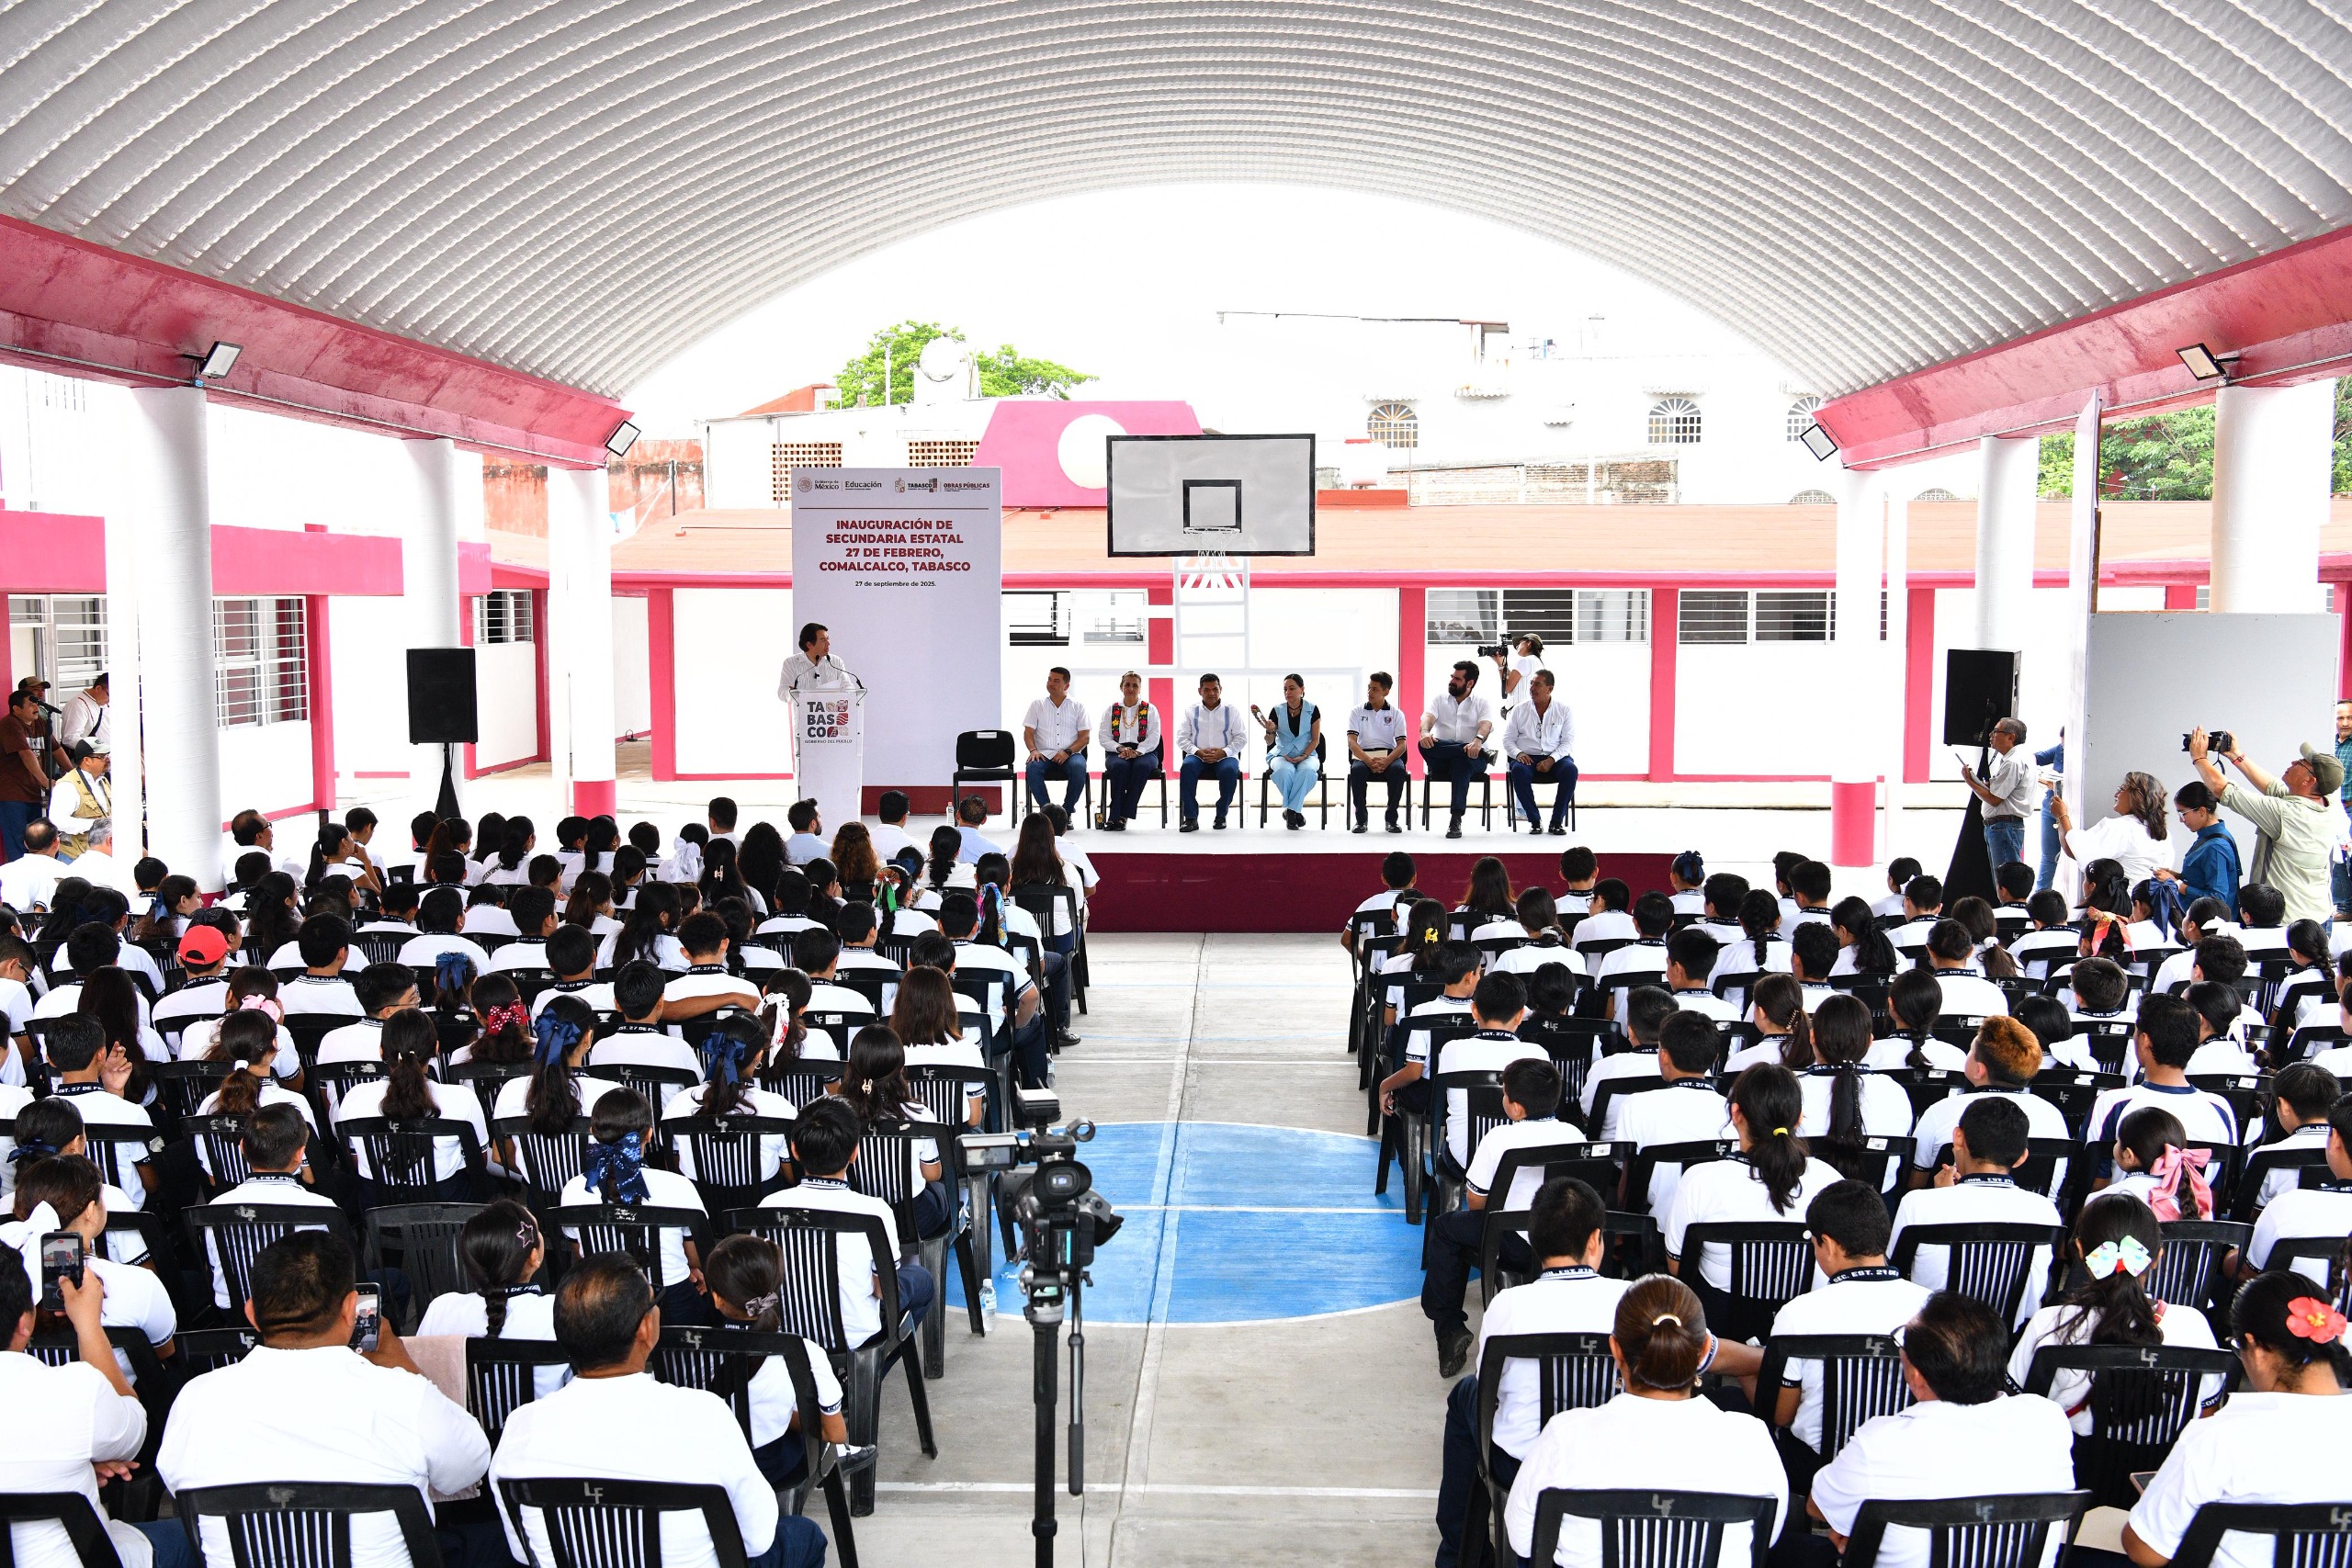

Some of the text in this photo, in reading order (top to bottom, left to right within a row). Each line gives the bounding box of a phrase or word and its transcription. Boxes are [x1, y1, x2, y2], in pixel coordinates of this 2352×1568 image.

[836, 517, 954, 530] INAUGURACIÓN DE
[825, 534, 964, 544] SECUNDARIA ESTATAL
[845, 547, 944, 559] 27 DE FEBRERO,
[819, 561, 971, 573] COMALCALCO, TABASCO
[807, 701, 825, 713] TA
[807, 714, 835, 726] BAS
[807, 726, 827, 738] CO
[2284, 965, 2293, 976] LF
[1415, 973, 1423, 983] LF
[814, 1014, 823, 1024] LF
[1451, 1015, 1463, 1026] LF
[1958, 1017, 1967, 1028] LF
[1549, 1021, 1558, 1032] LF
[345, 1065, 356, 1077] LF
[619, 1066, 631, 1079] LF
[922, 1066, 934, 1080] LF
[2226, 1078, 2236, 1090] LF
[2059, 1091, 2069, 1104] LF
[389, 1120, 399, 1134] LF
[1580, 1146, 1590, 1159] LF
[1716, 1142, 1727, 1156] LF
[777, 1211, 789, 1227] LF
[239, 1332, 255, 1349] LF
[684, 1330, 702, 1350] LF
[1579, 1335, 1598, 1356] LF
[1866, 1337, 1884, 1357] LF
[2140, 1348, 2159, 1369] LF
[583, 1481, 604, 1505] LF
